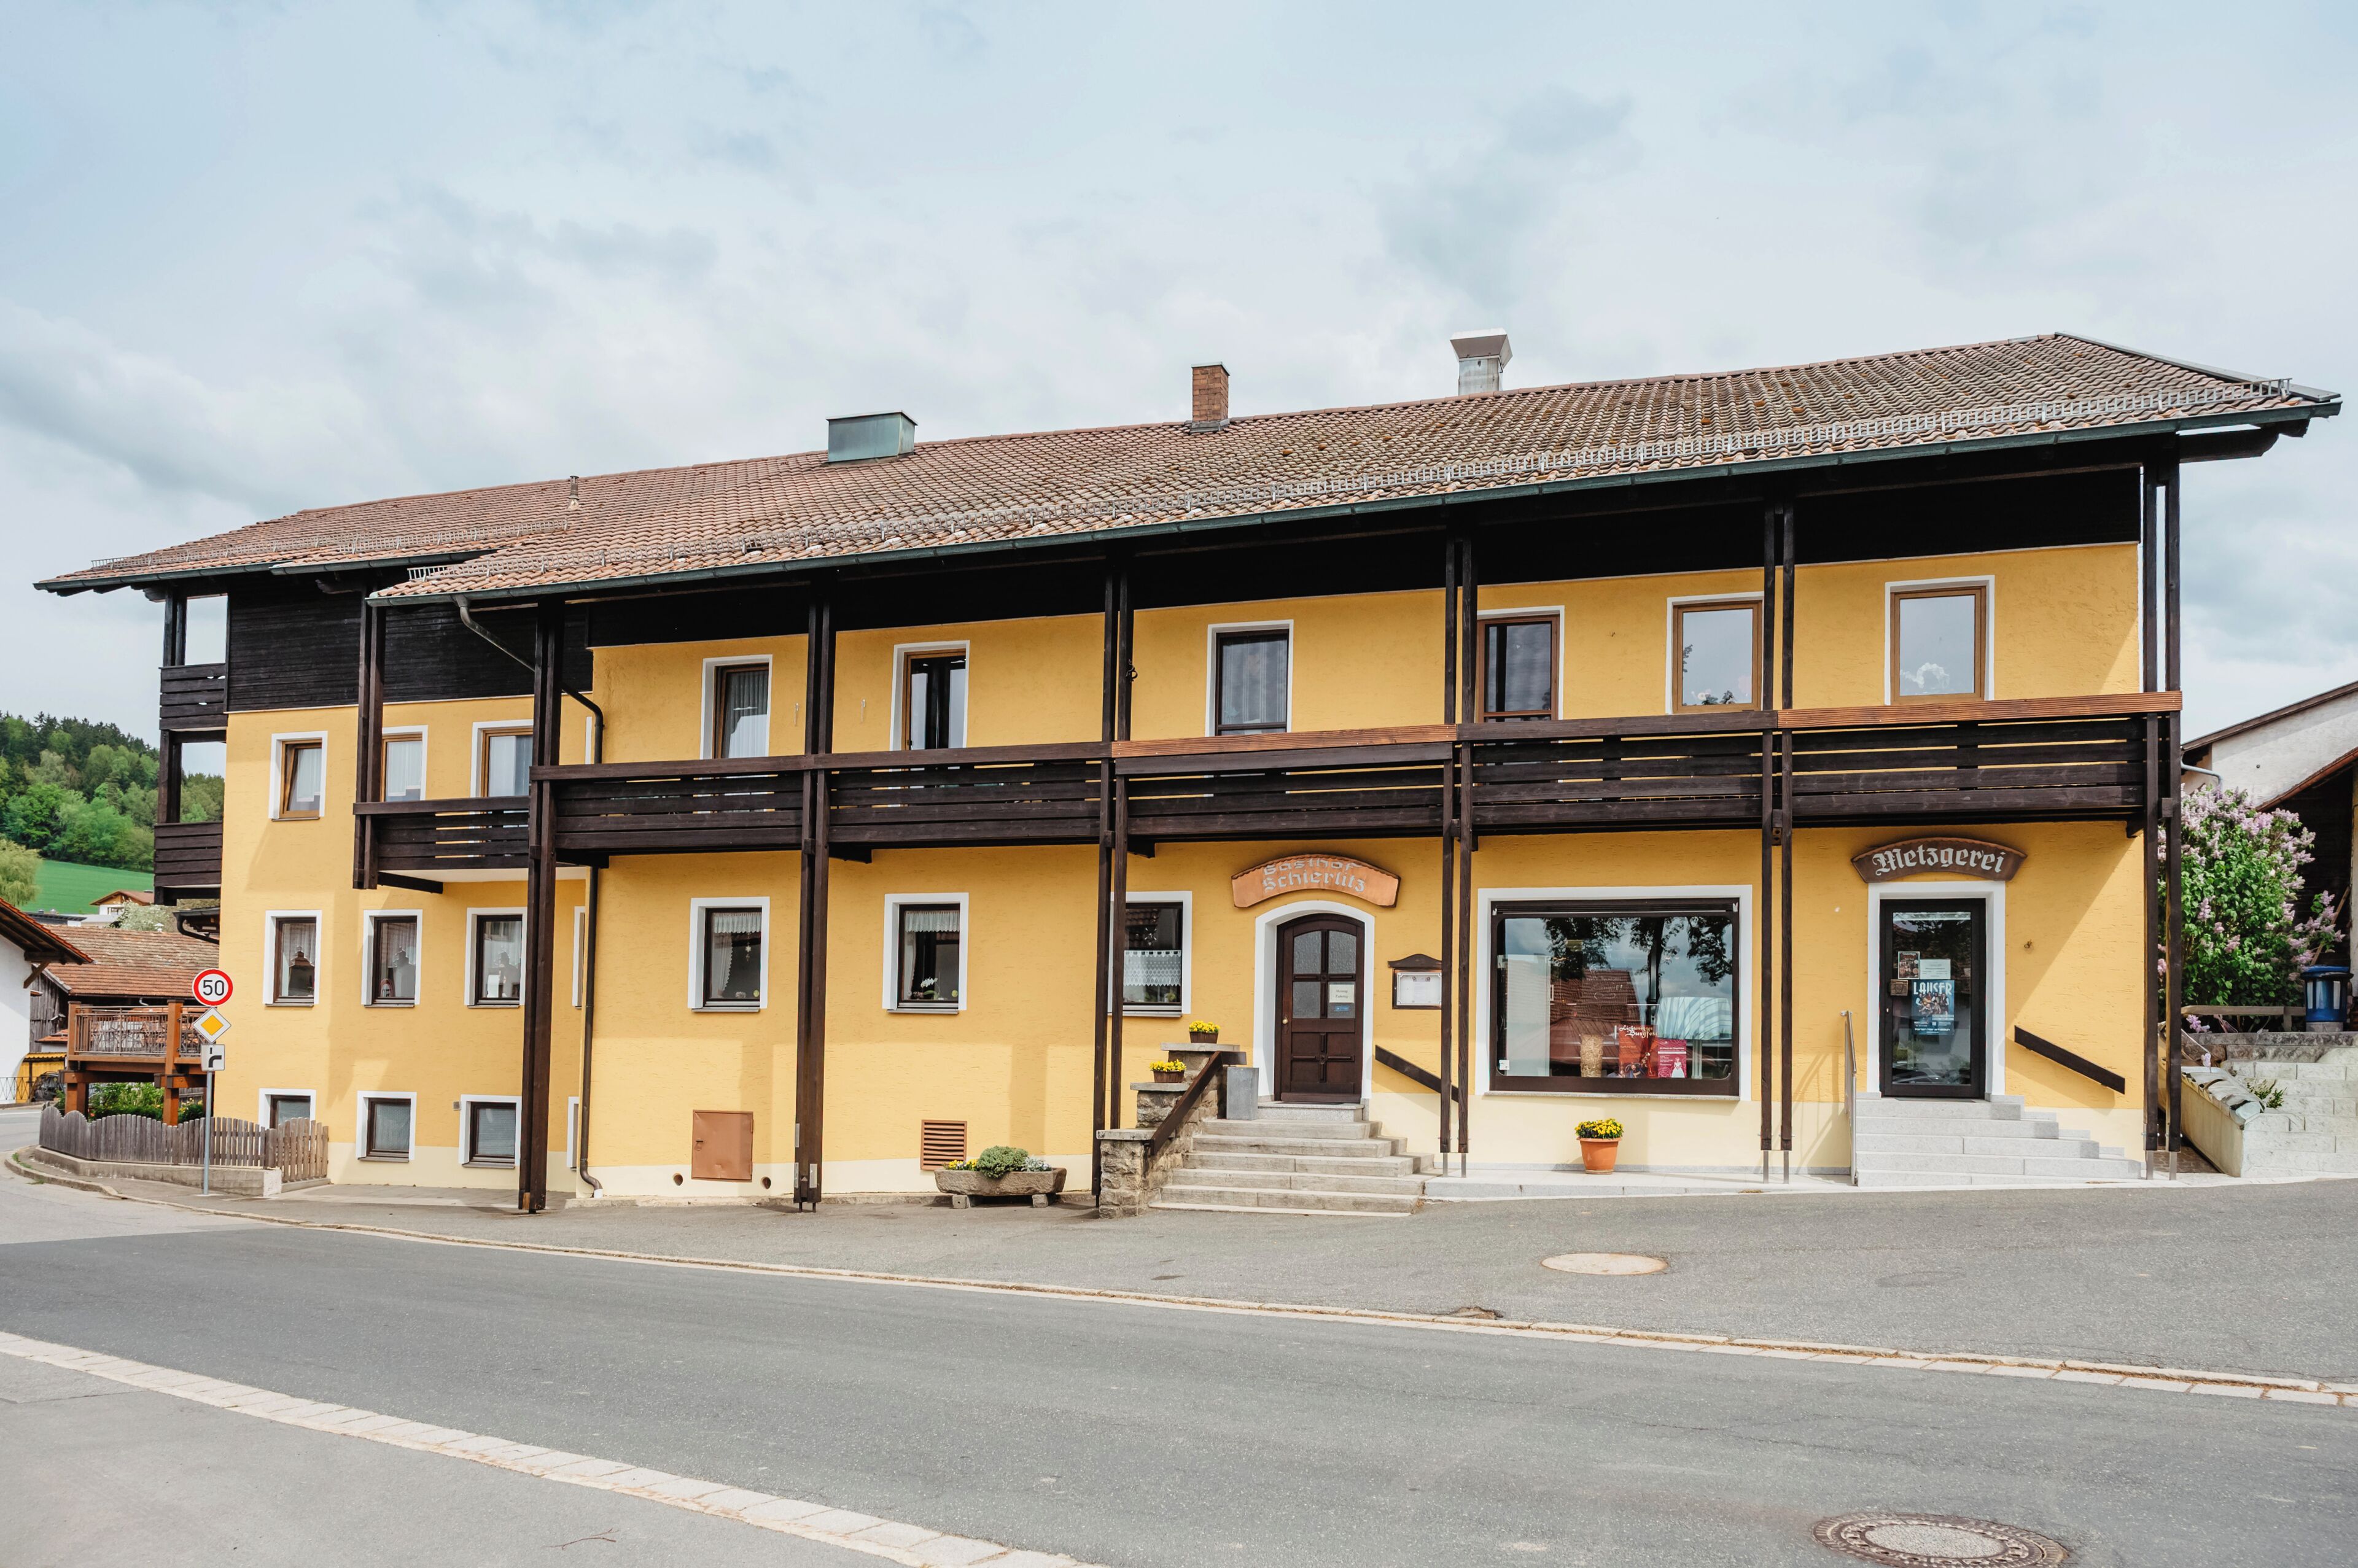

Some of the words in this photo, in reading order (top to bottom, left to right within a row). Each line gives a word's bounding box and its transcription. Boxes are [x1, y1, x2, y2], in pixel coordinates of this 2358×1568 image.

[1263, 858, 1362, 875] Gasthof
[1872, 845, 2006, 876] Metzgerei
[1263, 869, 1366, 893] Schierlitz
[203, 980, 225, 996] 50
